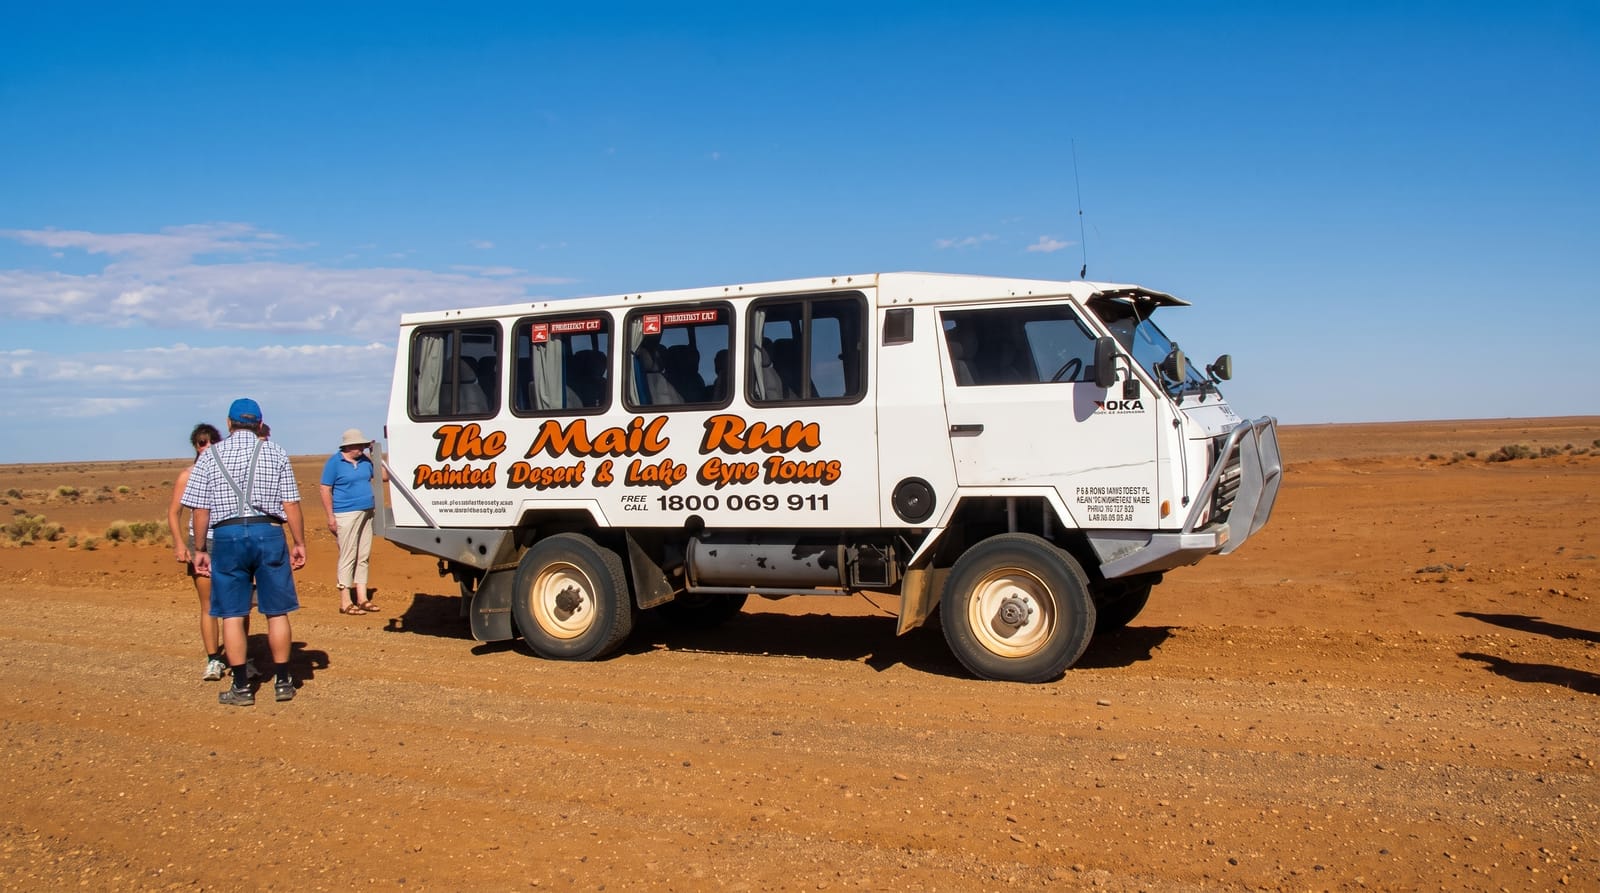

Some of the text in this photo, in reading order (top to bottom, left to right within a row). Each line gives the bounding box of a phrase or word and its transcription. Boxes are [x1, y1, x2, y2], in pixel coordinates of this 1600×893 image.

[1106, 400, 1144, 410] OKA
[432, 413, 821, 462] The Mail Run
[413, 455, 842, 491] Painted Desert & Lake Eyre Tours
[620, 495, 648, 503] FREE
[656, 494, 830, 511] 1800 069 911
